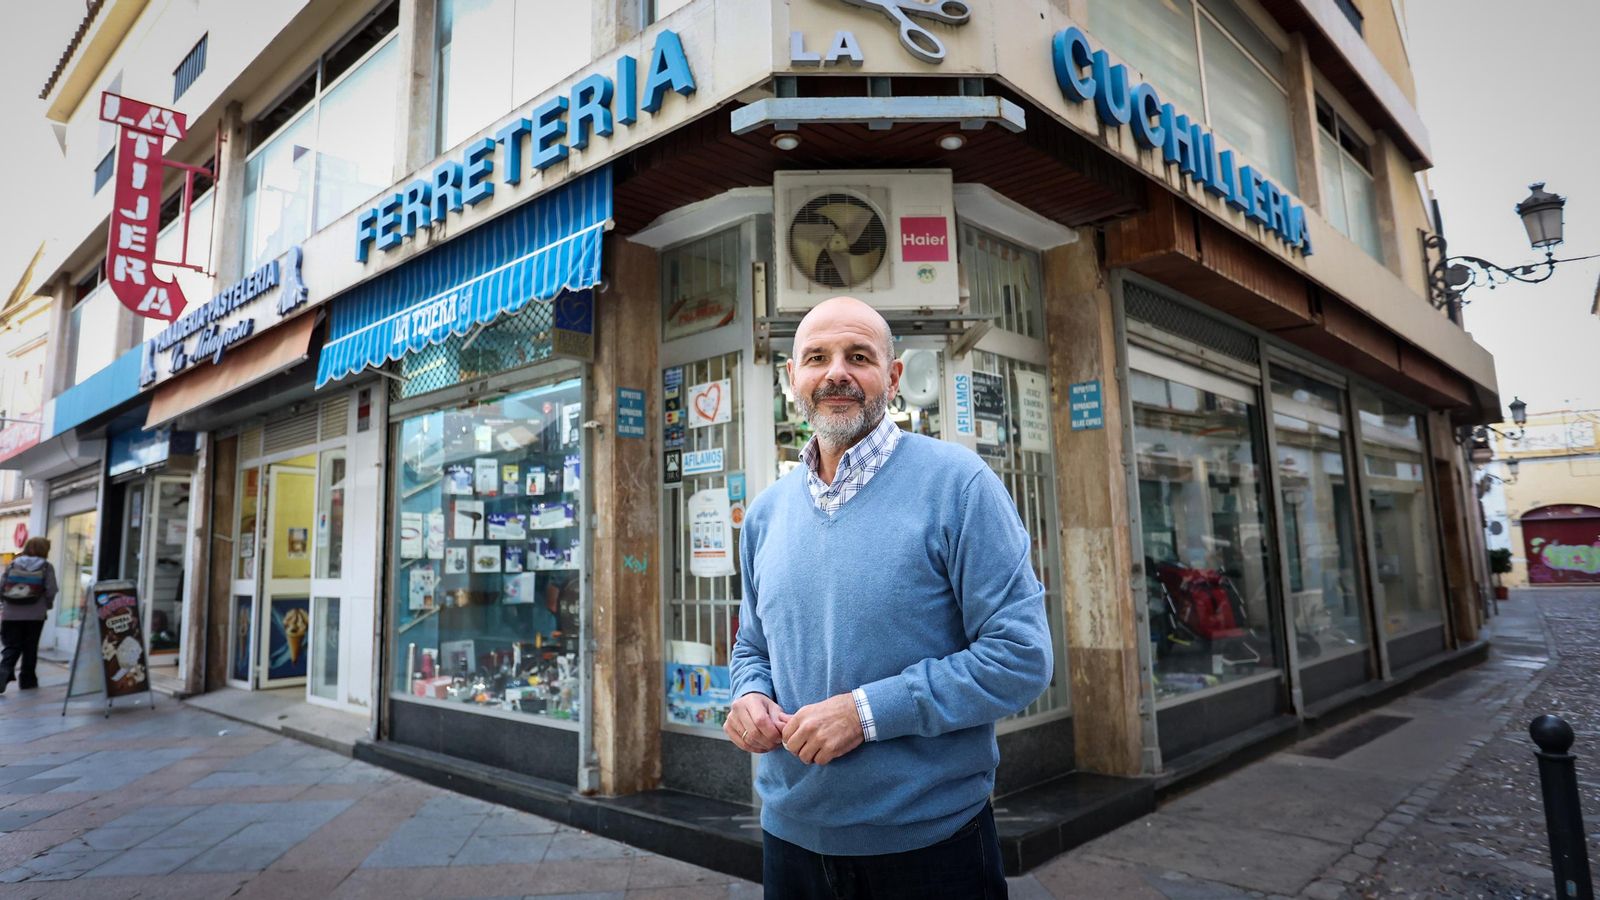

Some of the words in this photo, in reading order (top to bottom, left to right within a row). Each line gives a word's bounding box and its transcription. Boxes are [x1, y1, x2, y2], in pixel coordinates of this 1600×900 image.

[790, 31, 864, 66] LA
[102, 95, 183, 139] LA
[355, 28, 697, 264] FERRETERIA
[1052, 26, 1312, 256] CUCHILLERIA
[113, 131, 174, 317] TIJERA
[902, 232, 946, 246] Haier
[394, 314, 410, 344] LA
[955, 375, 968, 433] AFILAMOS
[684, 451, 721, 466] AFILAMOS
